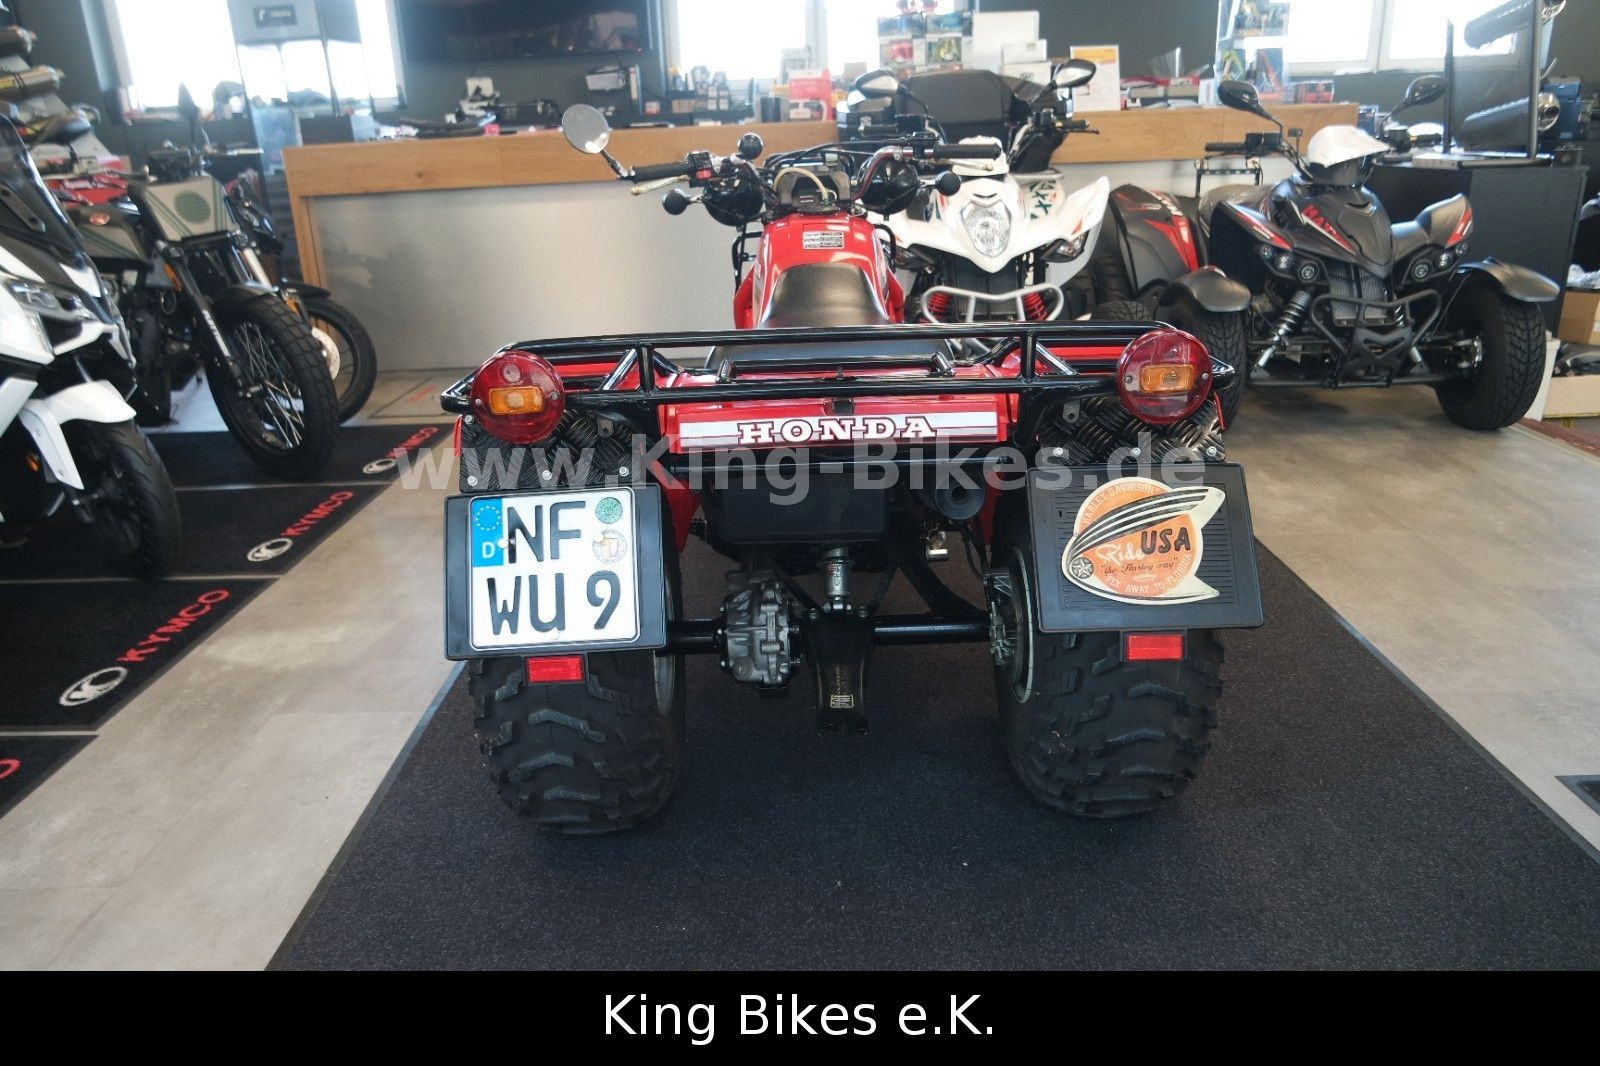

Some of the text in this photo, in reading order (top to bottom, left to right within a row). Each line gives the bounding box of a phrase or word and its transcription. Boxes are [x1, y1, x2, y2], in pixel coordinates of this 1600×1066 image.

[737, 416, 938, 445] HONDA
[281, 491, 354, 538] KYMCO
[507, 500, 586, 564] NF
[482, 542, 496, 559] D
[1095, 527, 1191, 566] Ride USA
[486, 570, 621, 636] WU 9
[1124, 584, 1150, 594] AWAY
[1153, 581, 1166, 592] TO
[116, 588, 230, 663] KYMCO
